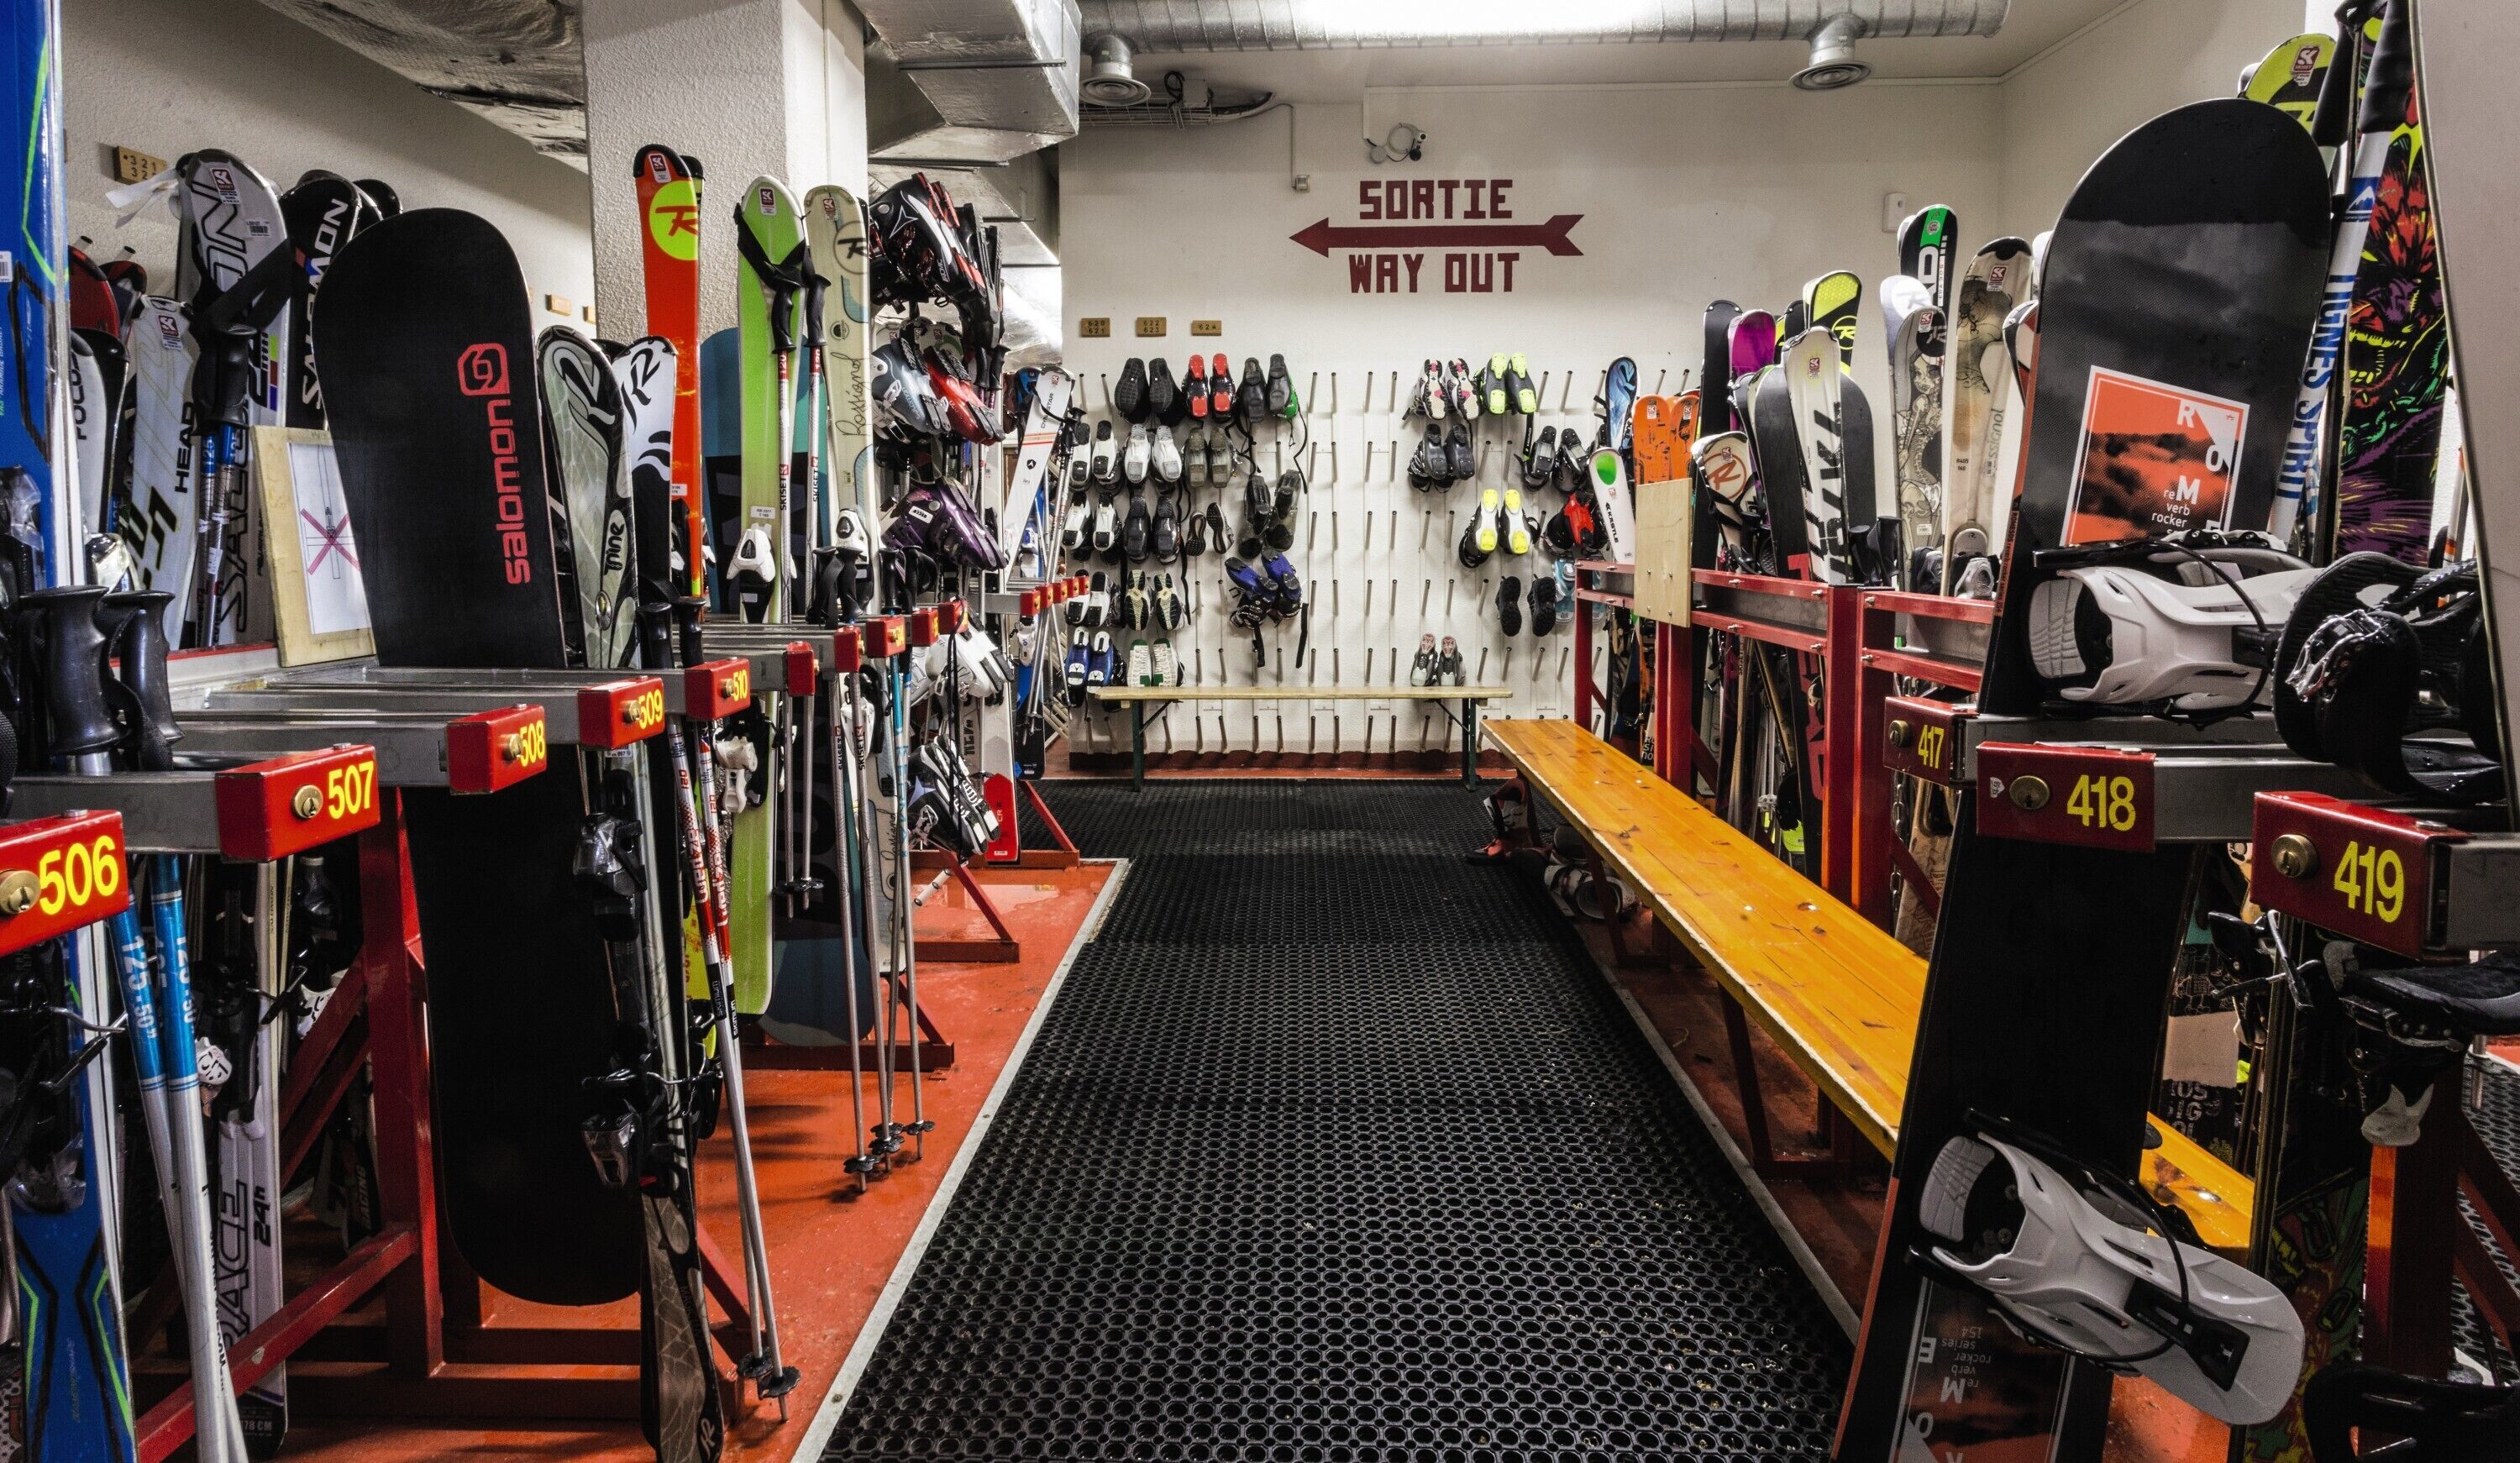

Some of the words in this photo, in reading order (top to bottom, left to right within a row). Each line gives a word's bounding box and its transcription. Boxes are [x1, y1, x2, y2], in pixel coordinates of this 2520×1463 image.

[1360, 179, 1513, 219] SORTIE
[1348, 254, 1425, 293] WAY
[1445, 253, 1520, 293] OUT
[302, 198, 349, 410] SAOMON
[2304, 275, 2356, 391] TIGNES
[1041, 392, 1054, 428] DYNSTAR
[175, 402, 196, 494] HEAD
[204, 438, 217, 464] 125
[1988, 407, 2004, 471] ssignol
[487, 398, 531, 585] salomon
[780, 478, 788, 511] SKISET
[2166, 503, 2191, 516] verb
[2151, 511, 2187, 527] rocker
[732, 669, 748, 702] 510
[638, 689, 664, 730] 509
[520, 720, 546, 767] 508
[858, 738, 866, 771] SKISET
[1918, 724, 1945, 769] 417
[328, 760, 375, 820] 507
[2066, 774, 2136, 831] 418
[39, 835, 119, 915] 506
[2333, 841, 2405, 923] 419
[1954, 1353, 1992, 1364] rocker
